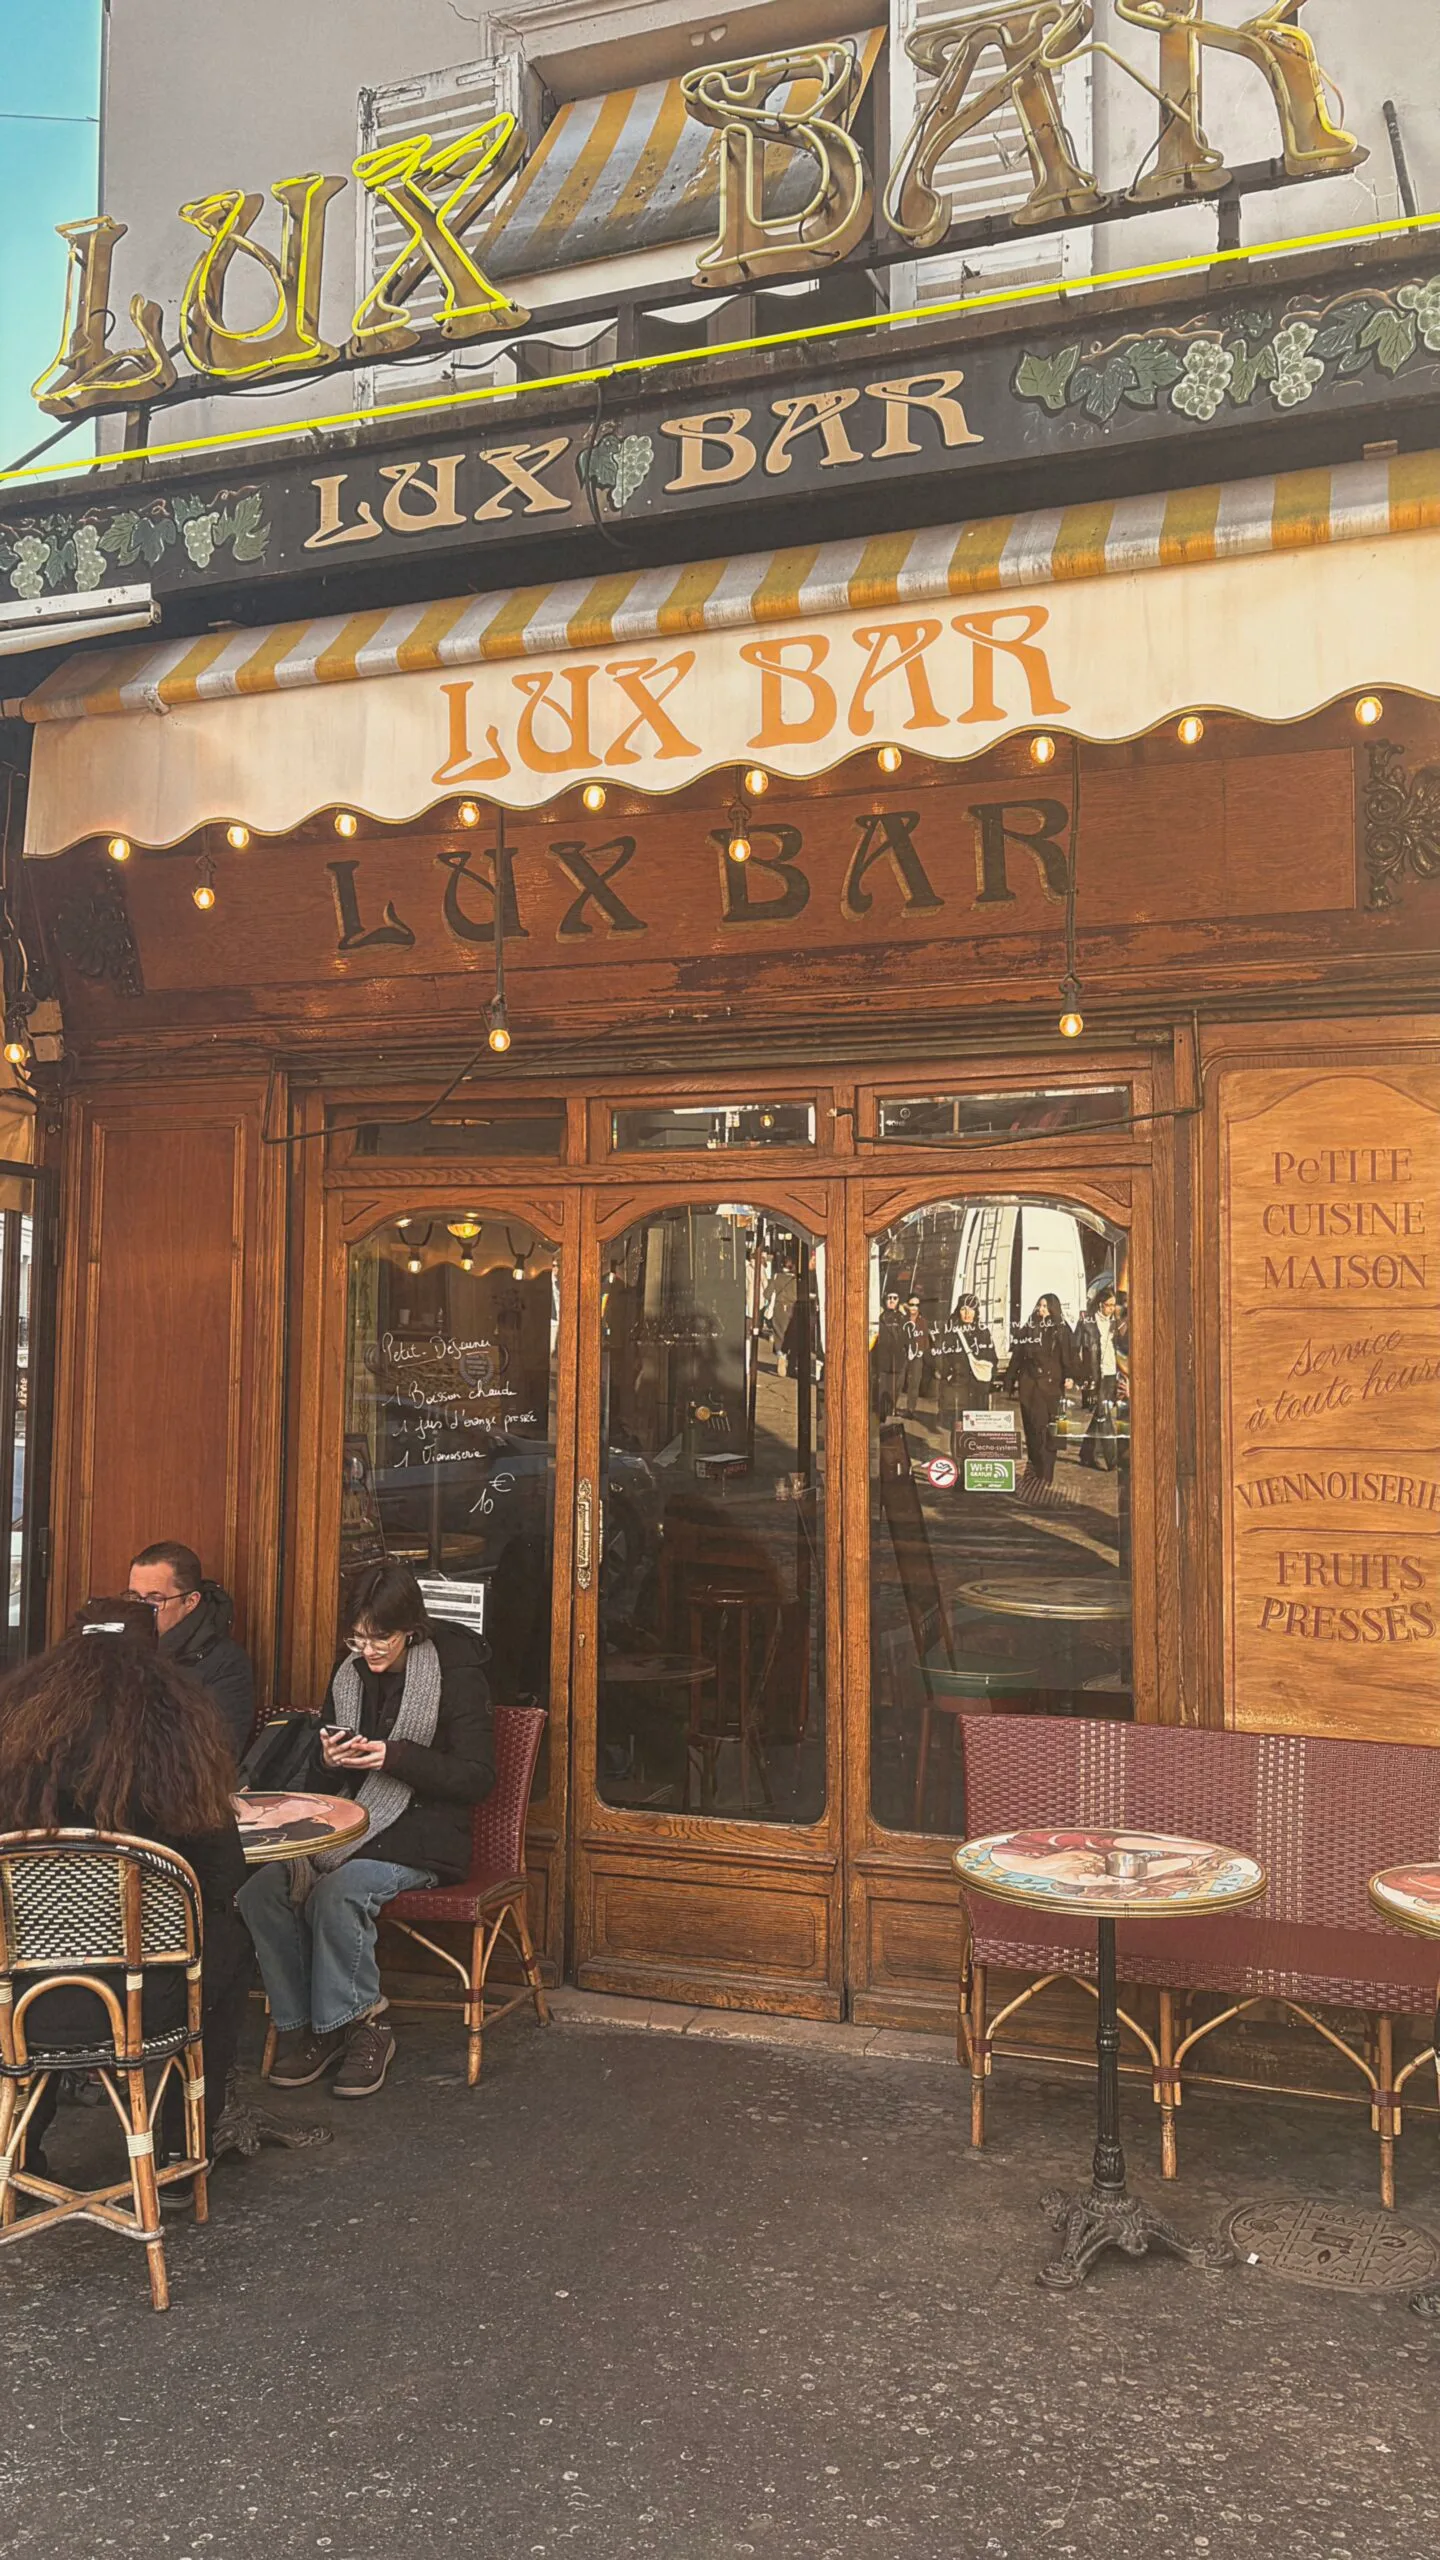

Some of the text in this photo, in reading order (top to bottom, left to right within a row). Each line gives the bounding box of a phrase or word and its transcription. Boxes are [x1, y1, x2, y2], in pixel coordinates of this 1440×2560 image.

[30, 0, 1371, 422] LUX BAR
[303, 371, 984, 550] LUX BAR
[432, 605, 1071, 786] LUX BAR
[325, 798, 1076, 951] LUX BAR
[1262, 1202, 1426, 1237] CUISINE
[1261, 1254, 1428, 1290] MAISON
[1288, 1329, 1402, 1380] Service
[381, 1385, 401, 1407] 1
[1245, 1398, 1270, 1433] à
[1273, 1376, 1353, 1421] toute
[392, 1419, 408, 1437] 1
[415, 1416, 443, 1440] jus
[393, 1450, 409, 1468] 1
[1276, 1550, 1426, 1592] FRUITS
[1256, 1592, 1437, 1643] PRESSÉS
[1324, 2213, 1361, 2227] GAZ
